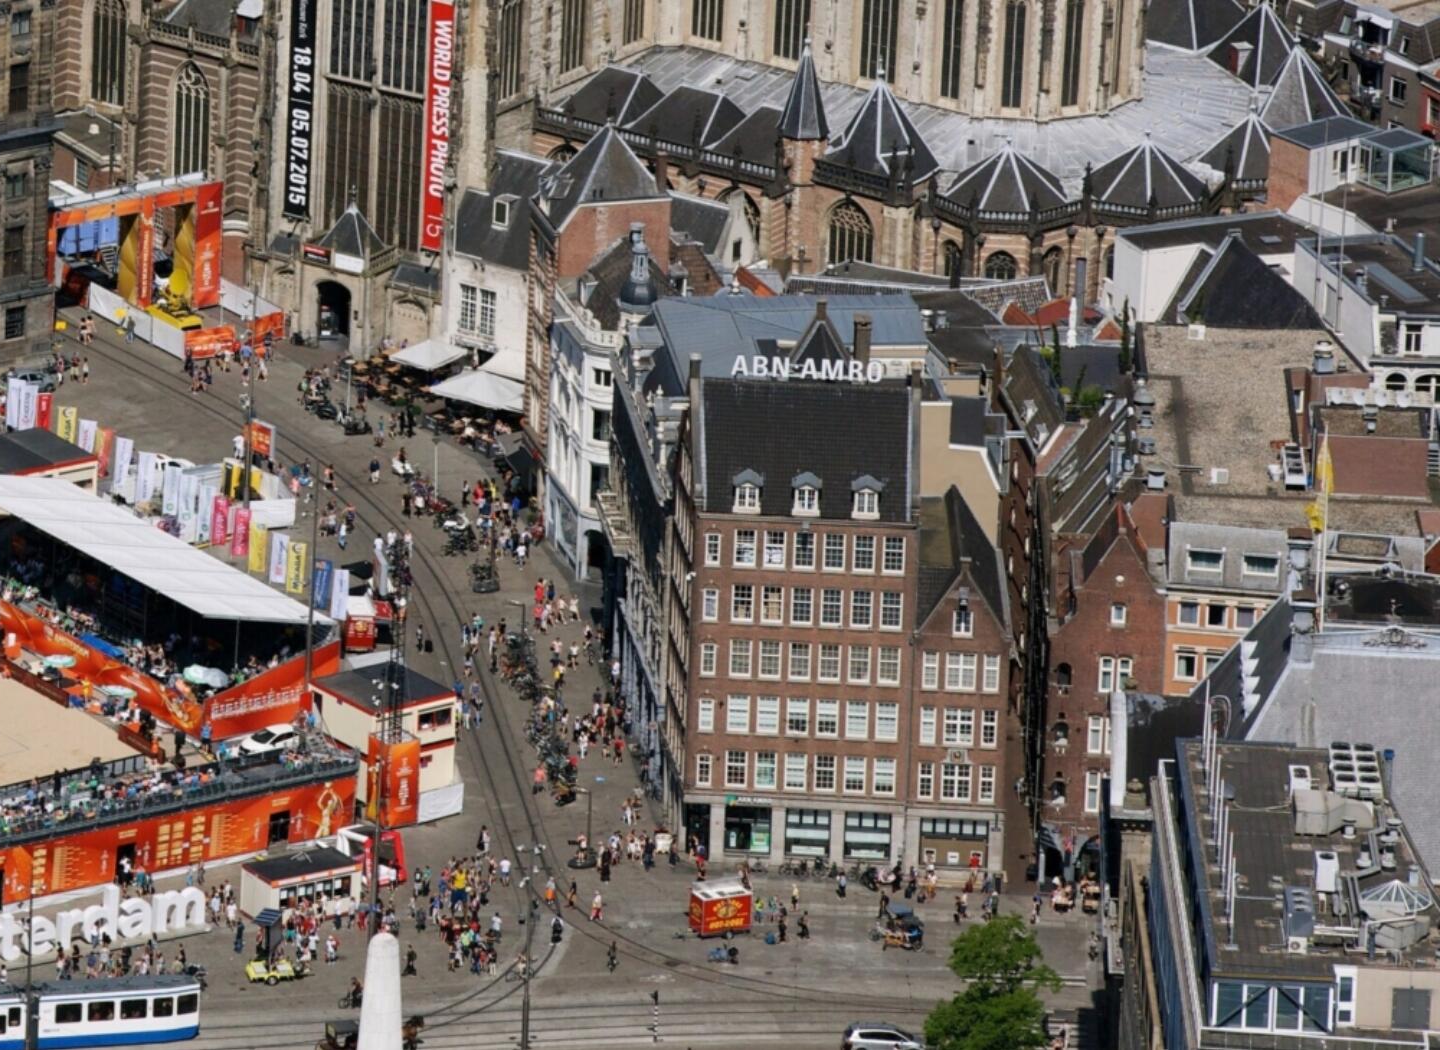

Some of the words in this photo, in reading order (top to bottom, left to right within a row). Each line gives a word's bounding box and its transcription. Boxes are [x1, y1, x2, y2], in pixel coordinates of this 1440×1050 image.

[293, 46, 312, 92] 18.04
[433, 20, 453, 80] WORLD
[431, 86, 451, 136] PRESS
[288, 108, 310, 206] 05.07.2015
